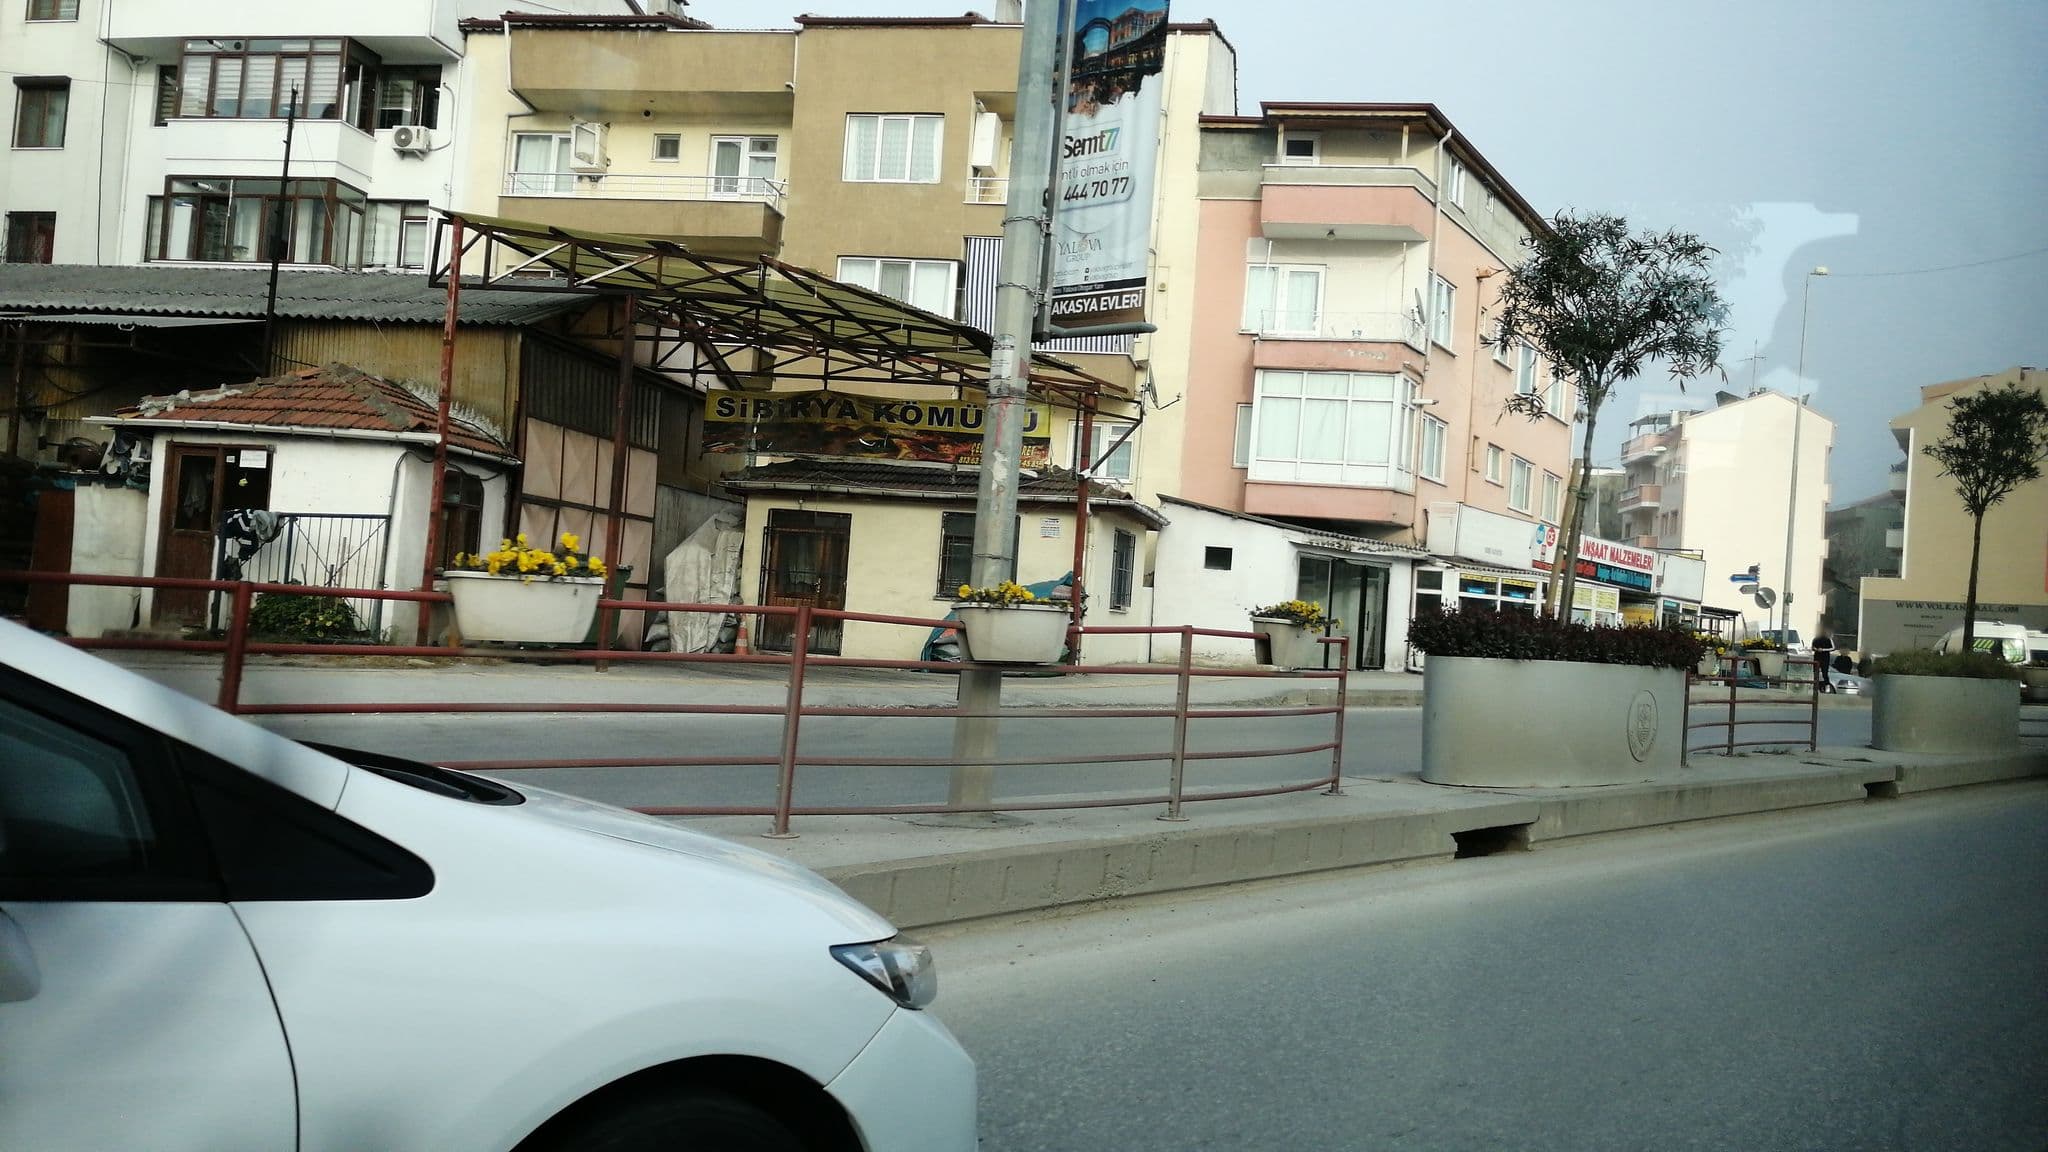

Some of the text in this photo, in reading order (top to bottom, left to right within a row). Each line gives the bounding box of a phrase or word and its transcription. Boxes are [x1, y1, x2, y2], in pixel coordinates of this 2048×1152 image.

[1081, 162, 1111, 178] olmak
[1112, 159, 1129, 175] için
[1064, 176, 1129, 202] 444 70 77
[1051, 289, 1143, 316] AKASYA EVLERİ
[873, 401, 1039, 433] KÖMÜÜ
[1582, 538, 1609, 559] İNŞAAT
[1609, 545, 1655, 571] MALZEMELERİ
